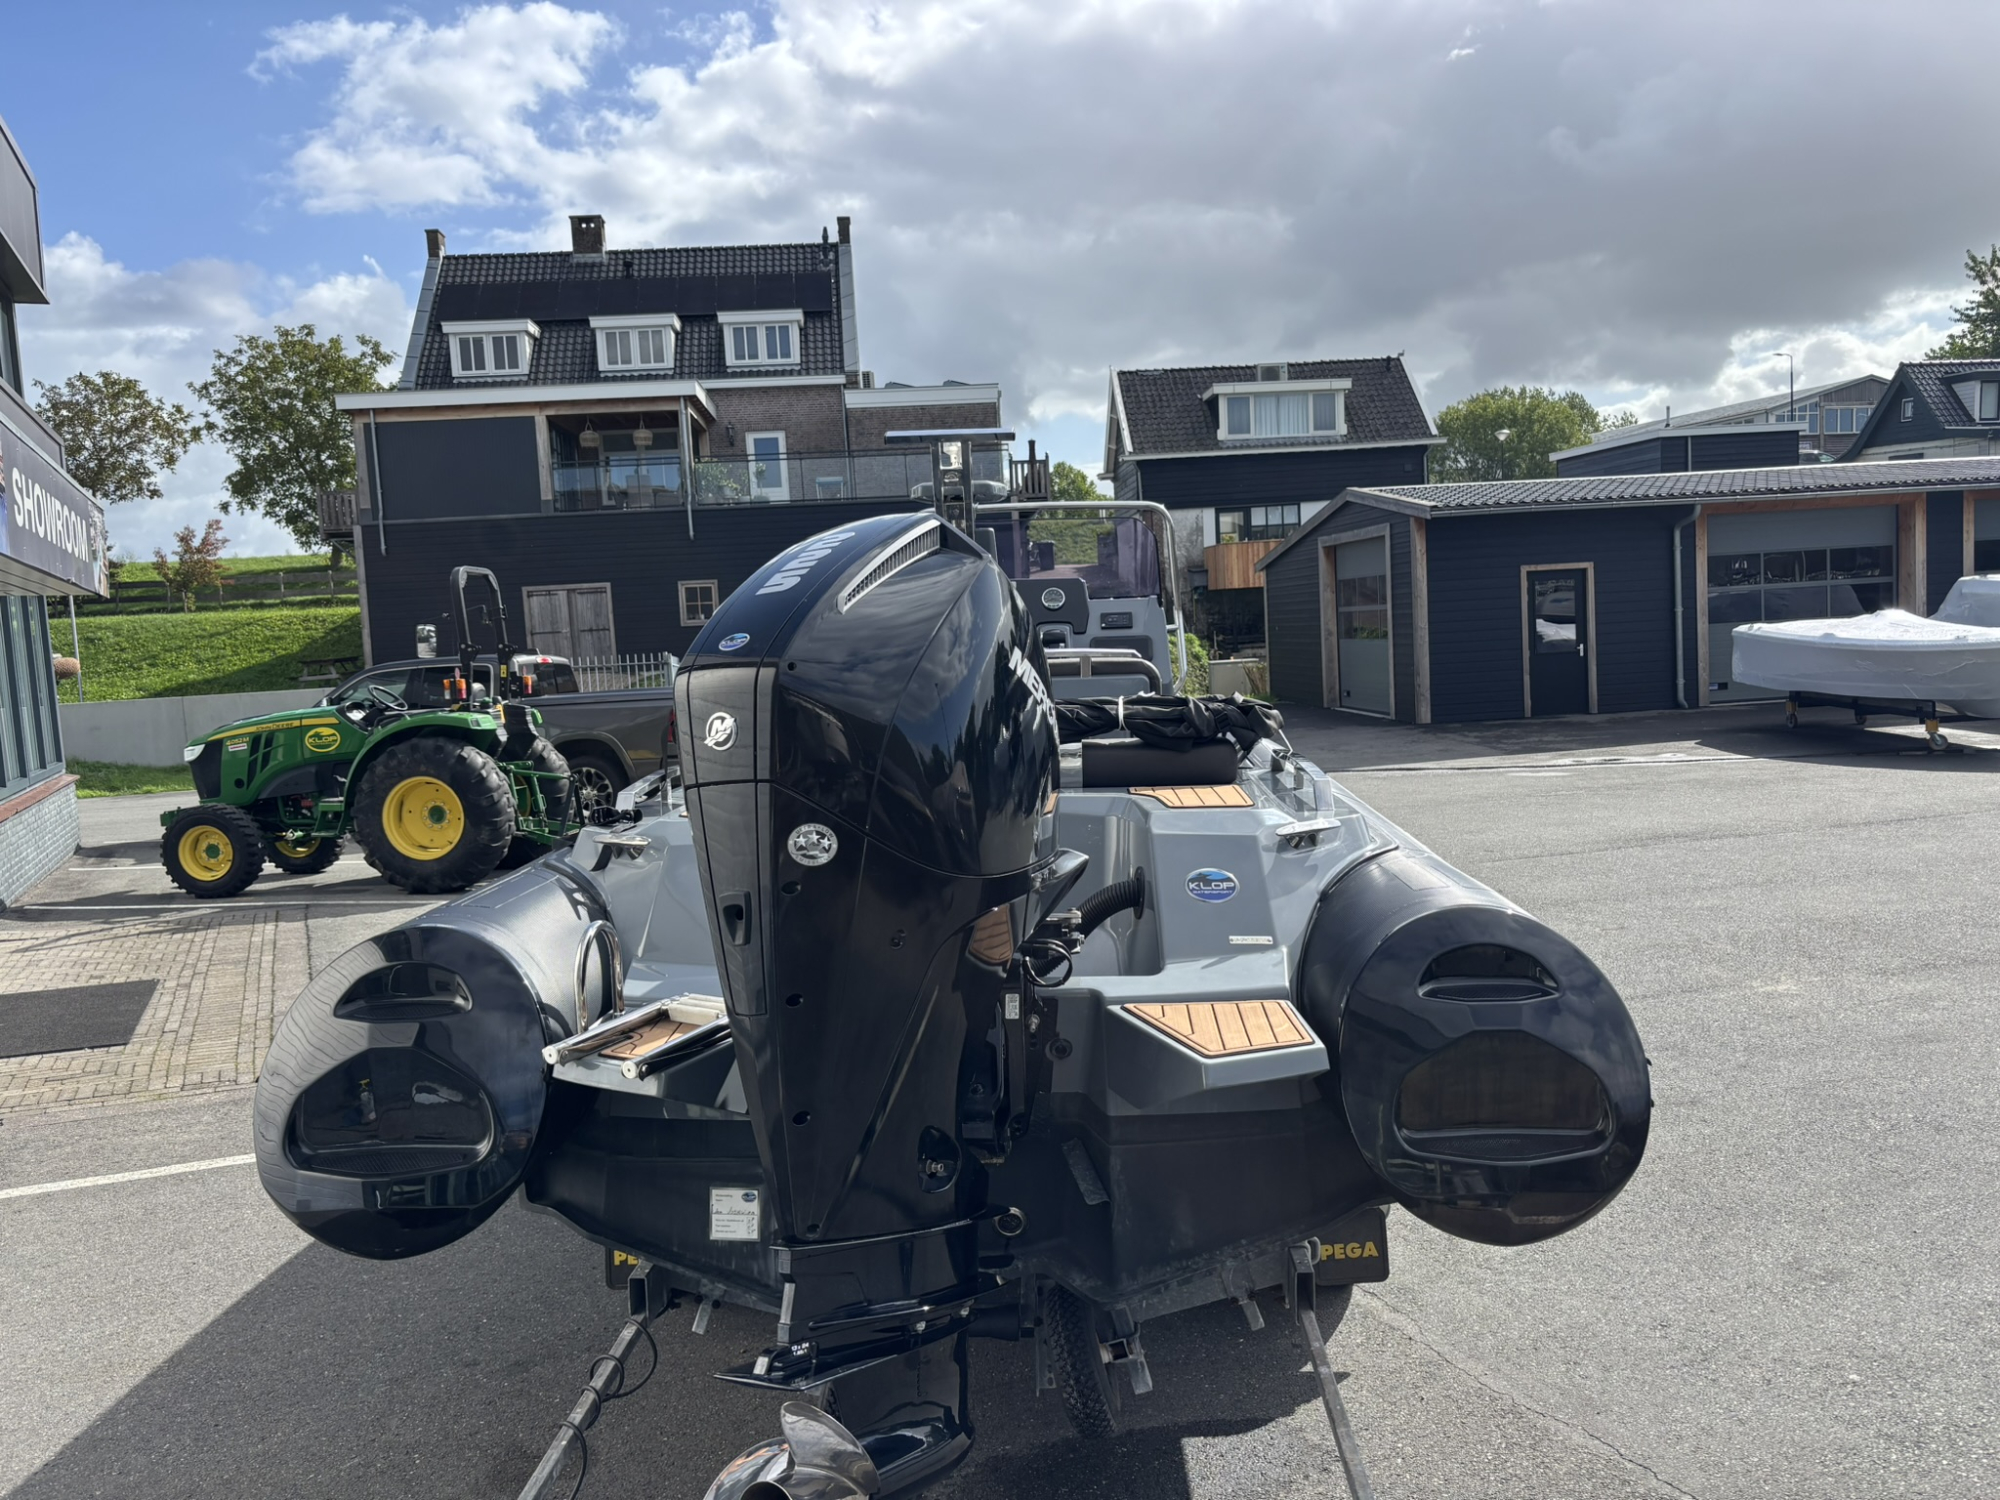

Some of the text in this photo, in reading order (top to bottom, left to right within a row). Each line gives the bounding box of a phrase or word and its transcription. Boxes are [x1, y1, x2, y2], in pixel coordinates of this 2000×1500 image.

[12, 467, 89, 563] SHOWROOM
[755, 532, 855, 595] 225
[1189, 882, 1234, 890] KLOP
[613, 1250, 639, 1266] PE
[1320, 1241, 1379, 1261] PEGA
